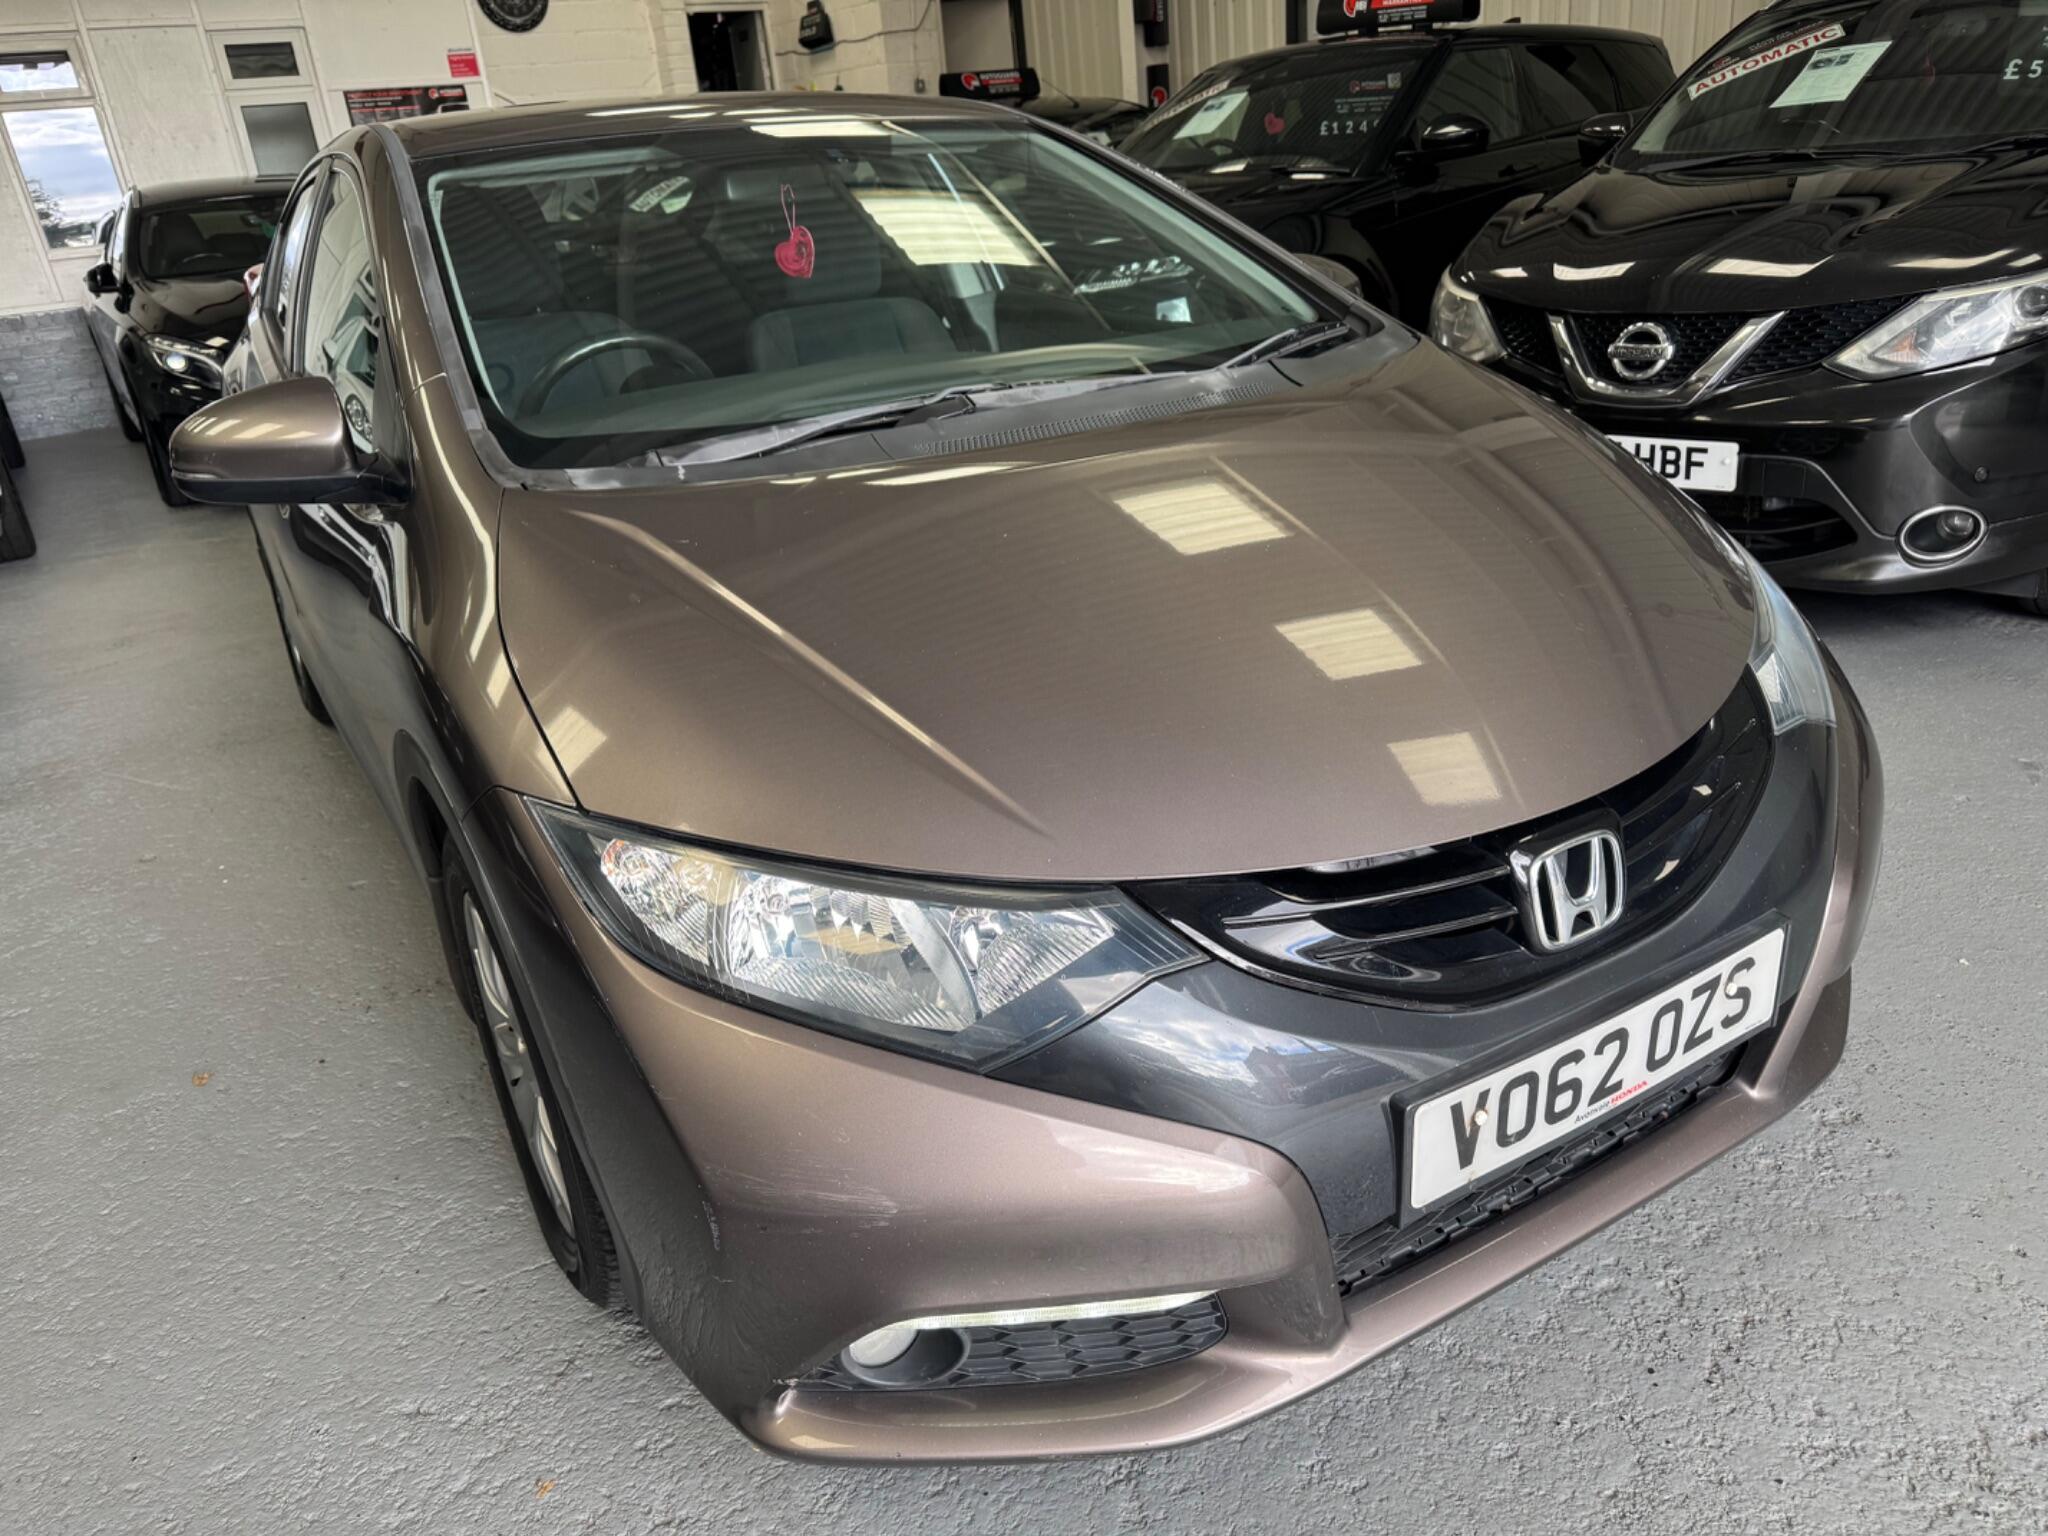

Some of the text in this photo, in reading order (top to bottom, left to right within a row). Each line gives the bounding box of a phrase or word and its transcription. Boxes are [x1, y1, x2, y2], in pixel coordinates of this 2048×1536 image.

[1695, 28, 1839, 94] AUTOMATIC
[1635, 443, 1709, 480] HBF
[1450, 956, 1756, 1171] VO62 OZS
